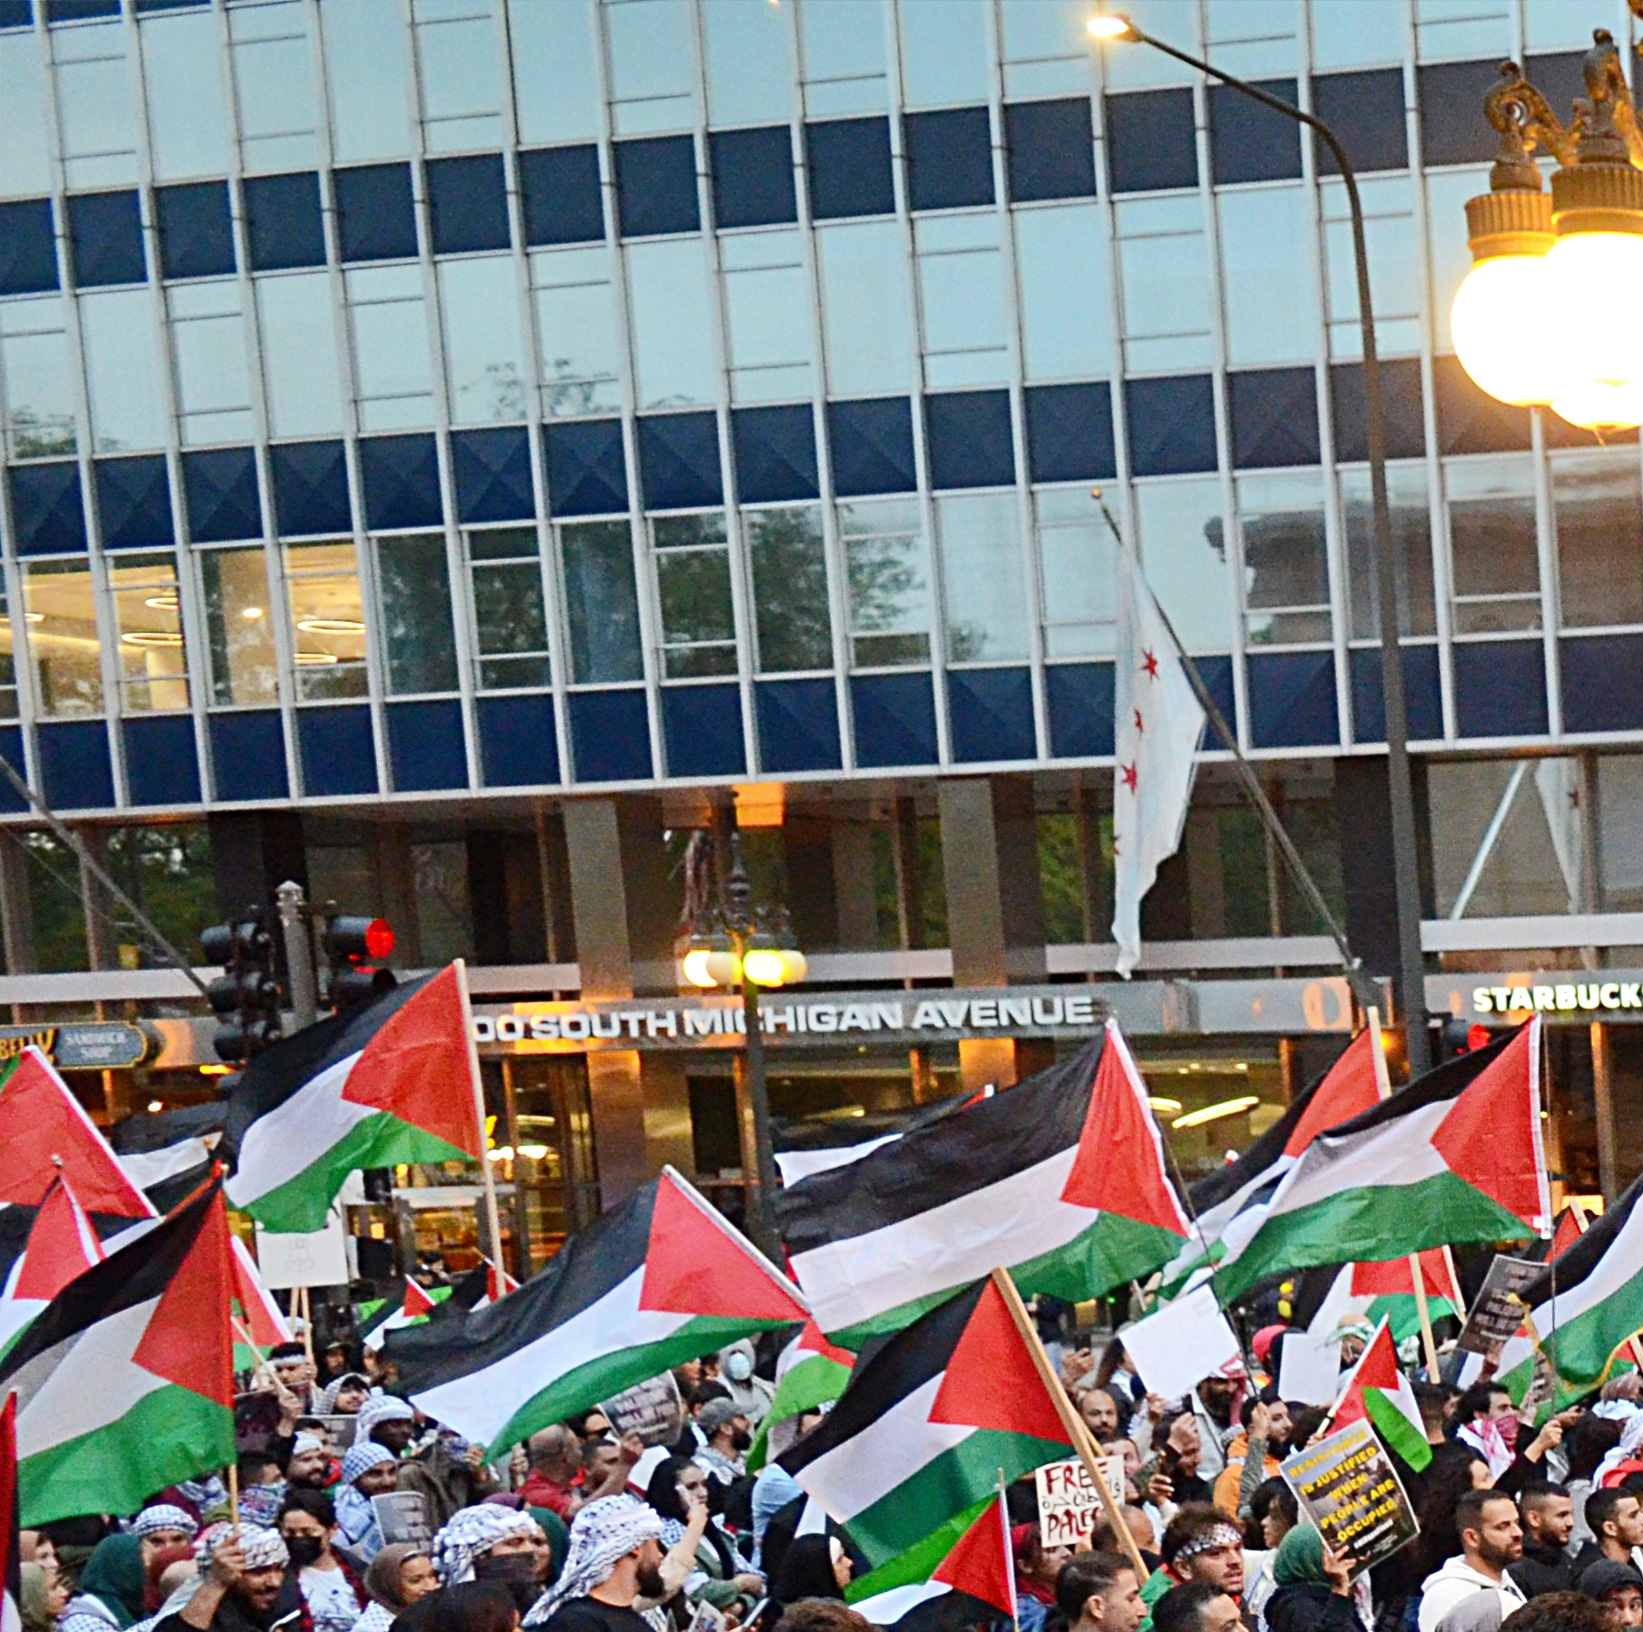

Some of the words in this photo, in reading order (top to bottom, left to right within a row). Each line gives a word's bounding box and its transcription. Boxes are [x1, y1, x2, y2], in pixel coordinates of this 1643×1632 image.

[472, 1013, 525, 1043] 00
[529, 1009, 678, 1041] SOUTH
[683, 1002, 904, 1035] MICHIGAN
[911, 995, 1094, 1030] AVENUE
[1316, 1446, 1377, 1487] JUSTIFIED
[1330, 1473, 1368, 1499] WHEN
[1321, 1495, 1370, 1529] PEOPLE
[1370, 1478, 1396, 1500] ARE
[1337, 1497, 1397, 1542] OCCUPIED
